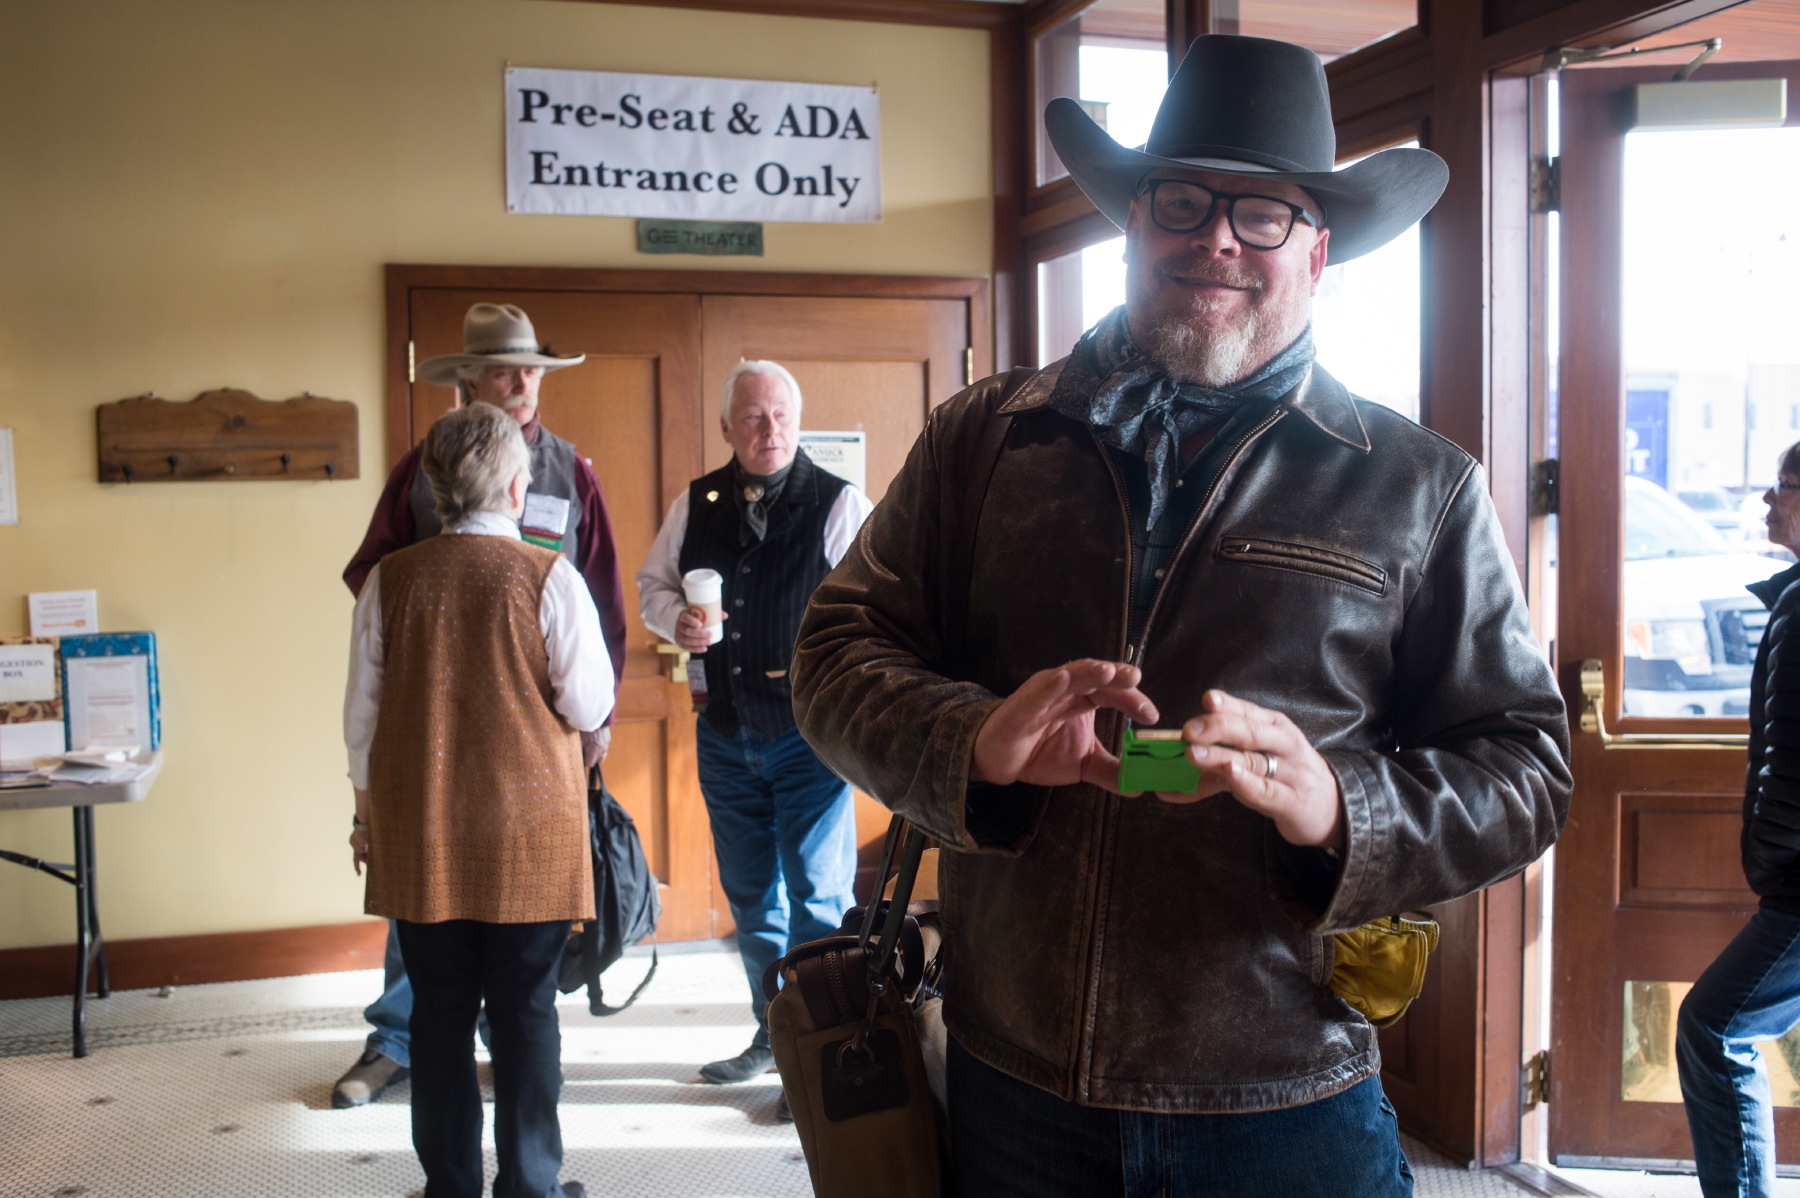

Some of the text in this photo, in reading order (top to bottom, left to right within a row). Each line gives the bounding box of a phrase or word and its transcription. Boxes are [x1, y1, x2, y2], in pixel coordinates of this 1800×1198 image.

[517, 87, 872, 141] Pre-Seat & ADA
[528, 150, 862, 208] Entrance Only
[684, 230, 758, 248] THEATER
